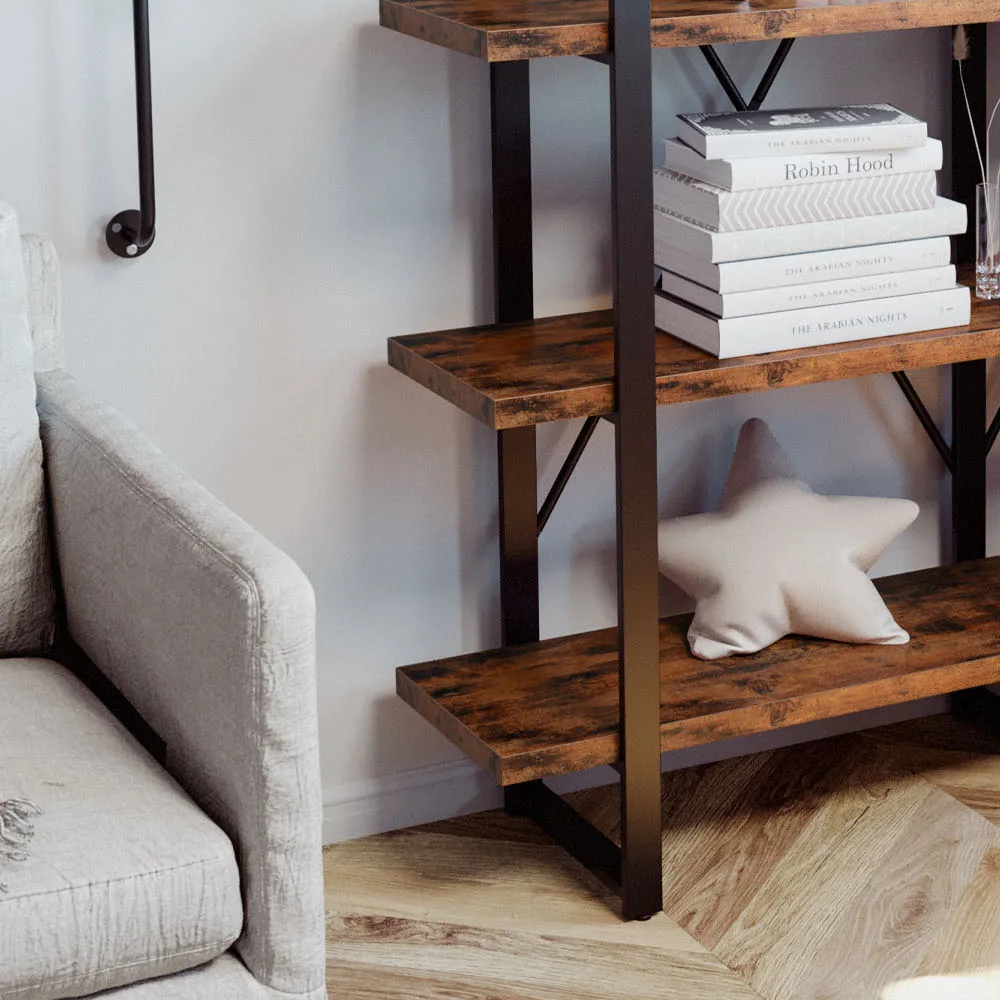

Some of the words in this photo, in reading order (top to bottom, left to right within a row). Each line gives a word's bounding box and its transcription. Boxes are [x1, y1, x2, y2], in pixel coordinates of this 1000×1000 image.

[784, 160, 840, 181] Robin
[846, 152, 895, 174] Hood
[790, 323, 813, 336] THE
[816, 317, 864, 332] ARABIAN
[866, 310, 908, 325] NIGHTS
